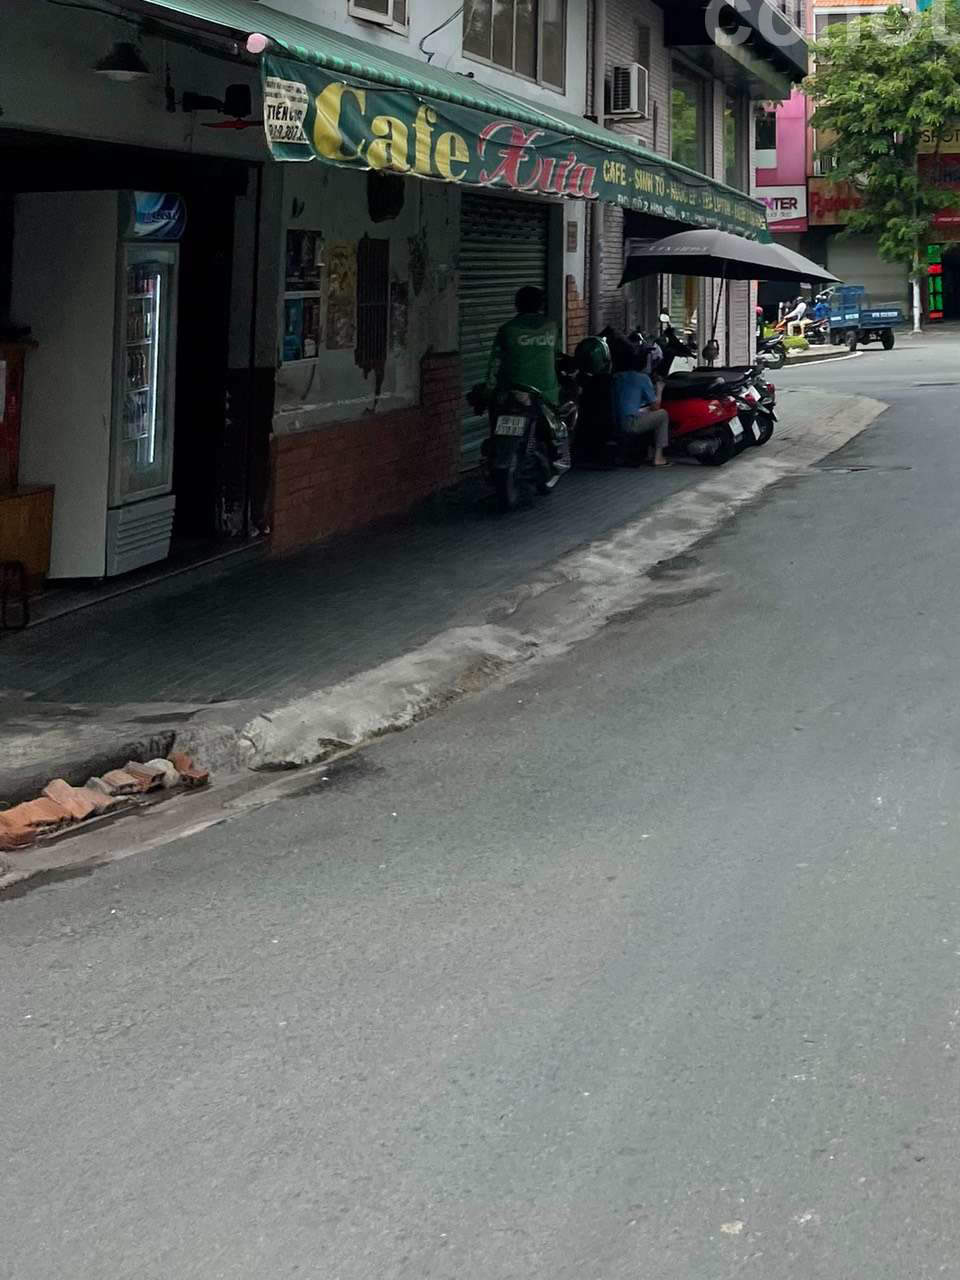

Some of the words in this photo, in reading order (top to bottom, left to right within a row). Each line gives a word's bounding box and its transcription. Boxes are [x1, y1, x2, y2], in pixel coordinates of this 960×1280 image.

[313, 81, 470, 182] Cafe
[476, 120, 600, 199] Xưa
[603, 159, 627, 186] CAFE
[519, 329, 556, 347] Grab
